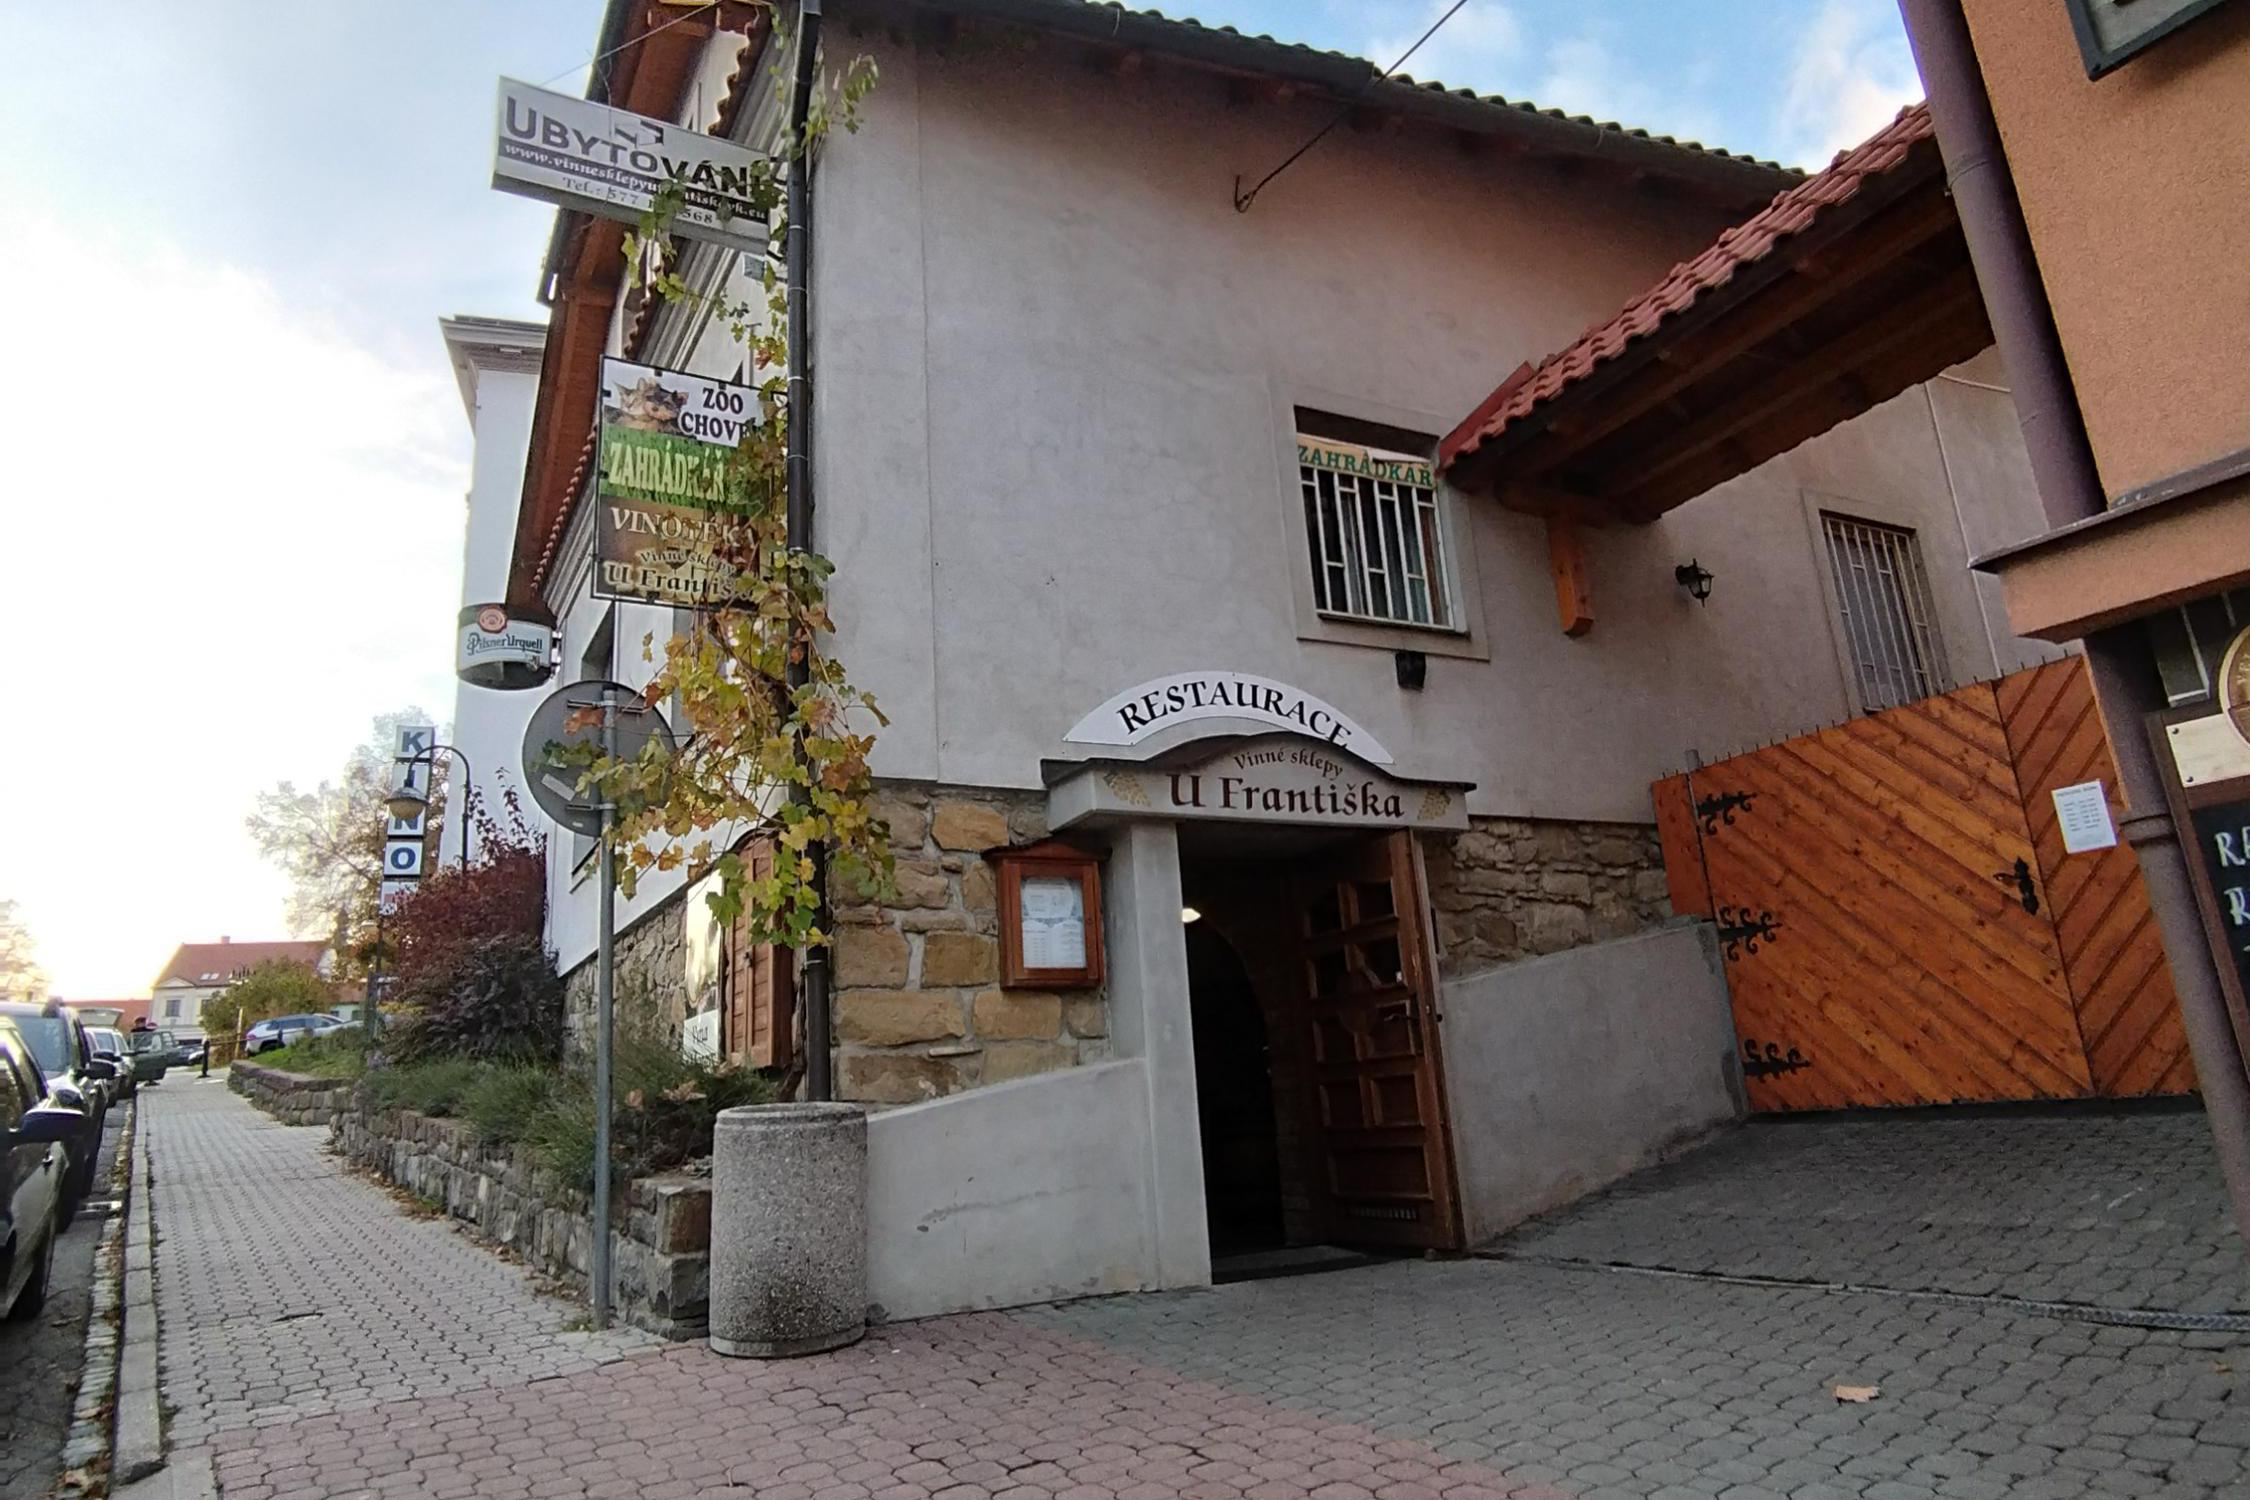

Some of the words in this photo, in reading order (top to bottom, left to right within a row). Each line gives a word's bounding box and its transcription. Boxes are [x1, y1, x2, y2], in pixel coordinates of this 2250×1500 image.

[505, 96, 762, 200] UBYTOVÁN
[703, 387, 743, 415] ZOO
[689, 551, 737, 576] skepy
[607, 564, 630, 584] U
[641, 568, 752, 599] Františ
[467, 632, 507, 656] Pilsner
[506, 633, 543, 653] Urquell
[1116, 680, 1351, 749] RESTAURACE
[1234, 748, 1286, 771] Vinné
[1290, 748, 1344, 781] sklepy
[1167, 773, 1207, 809] U
[1218, 776, 1405, 819] Františka
